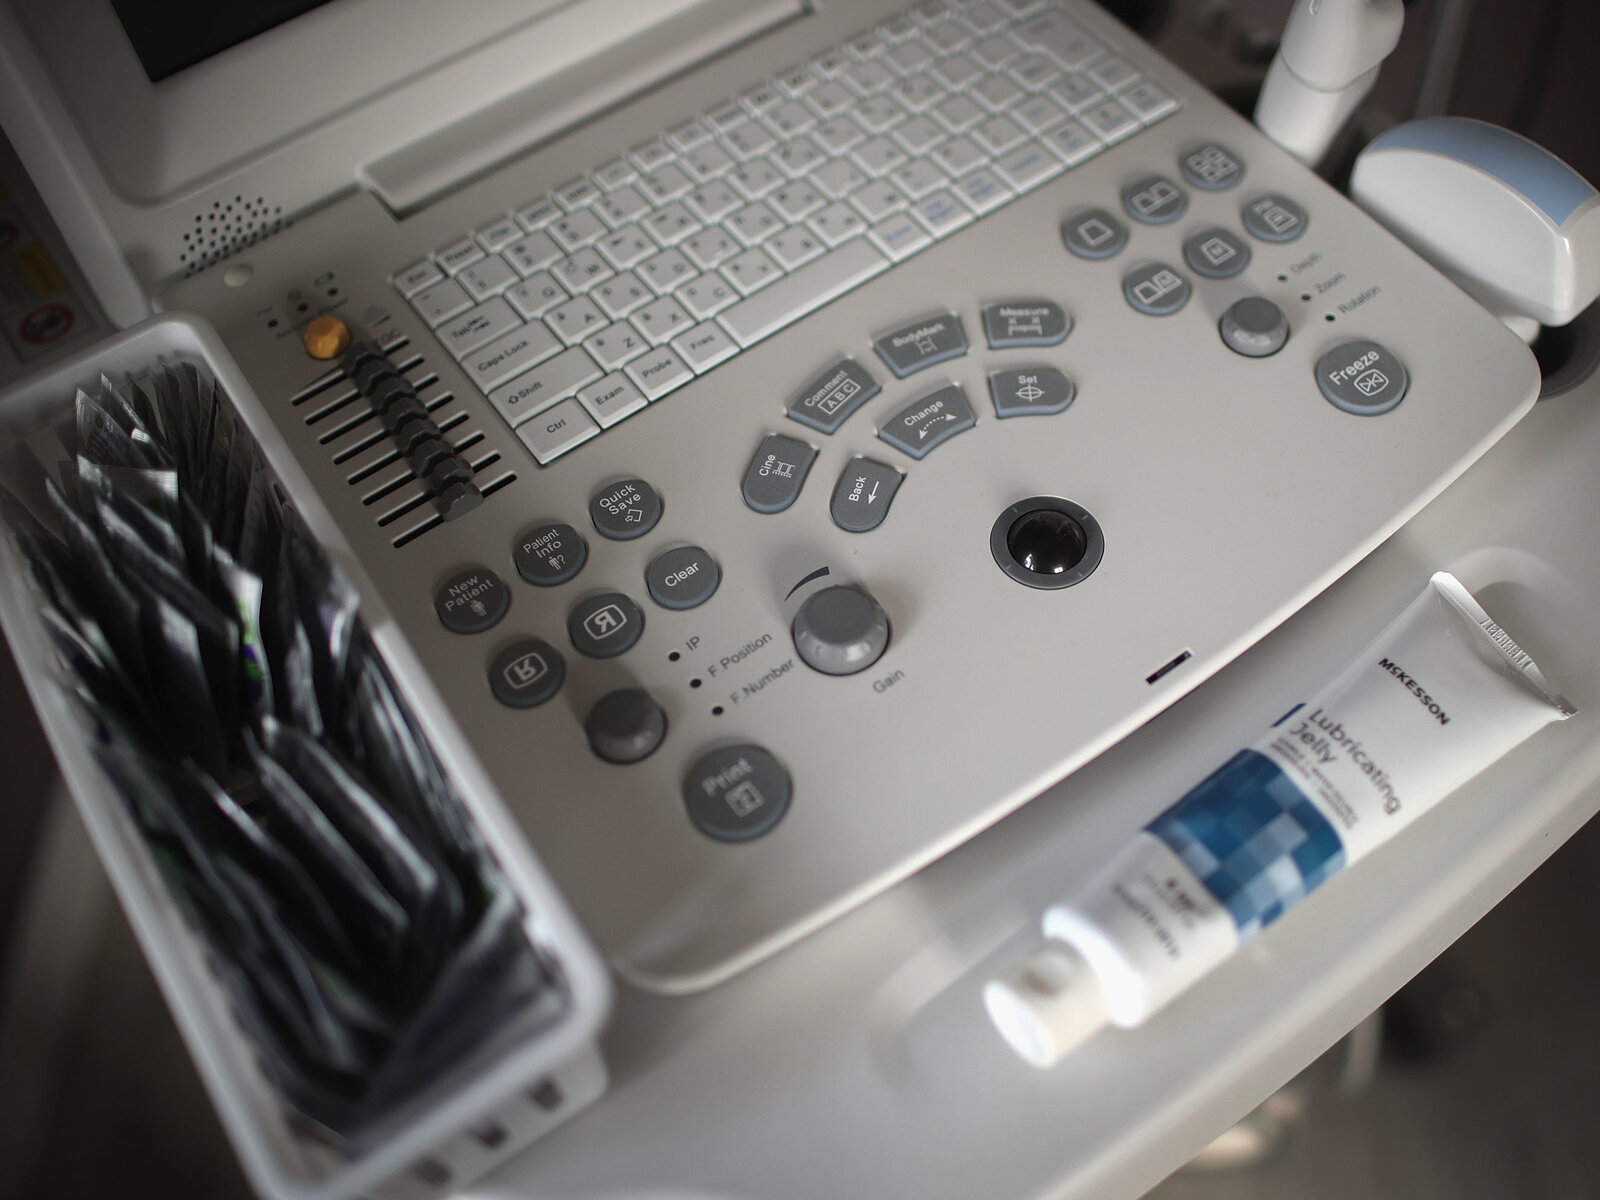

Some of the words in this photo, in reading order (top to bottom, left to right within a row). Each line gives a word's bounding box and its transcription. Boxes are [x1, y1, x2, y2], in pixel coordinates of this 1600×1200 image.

[1315, 272, 1346, 294] Zoom
[999, 306, 1050, 318] Measure
[1338, 285, 1382, 314] Rotation
[892, 321, 946, 349] BodyMark
[477, 352, 506, 373] Caps
[641, 357, 674, 378] Probe
[1329, 350, 1381, 386] Freeze
[517, 380, 545, 399] Shift
[804, 369, 849, 408] Comment
[1017, 375, 1039, 385] Set
[594, 384, 625, 406] Exam
[545, 417, 568, 435] Ctrl
[904, 399, 945, 427] Change
[758, 453, 776, 477] Cine
[599, 482, 637, 509] Quick
[848, 474, 868, 502] Back
[608, 492, 643, 515] Save
[522, 528, 560, 555] Patient
[536, 539, 562, 559] Info
[448, 574, 479, 598] New
[664, 560, 700, 588] Clear
[444, 578, 494, 612] Patient
[685, 635, 702, 652] IP
[871, 667, 906, 695] Gain
[1289, 721, 1339, 764] Jelly
[1308, 708, 1402, 815] Lubricating
[700, 756, 755, 798] Print
